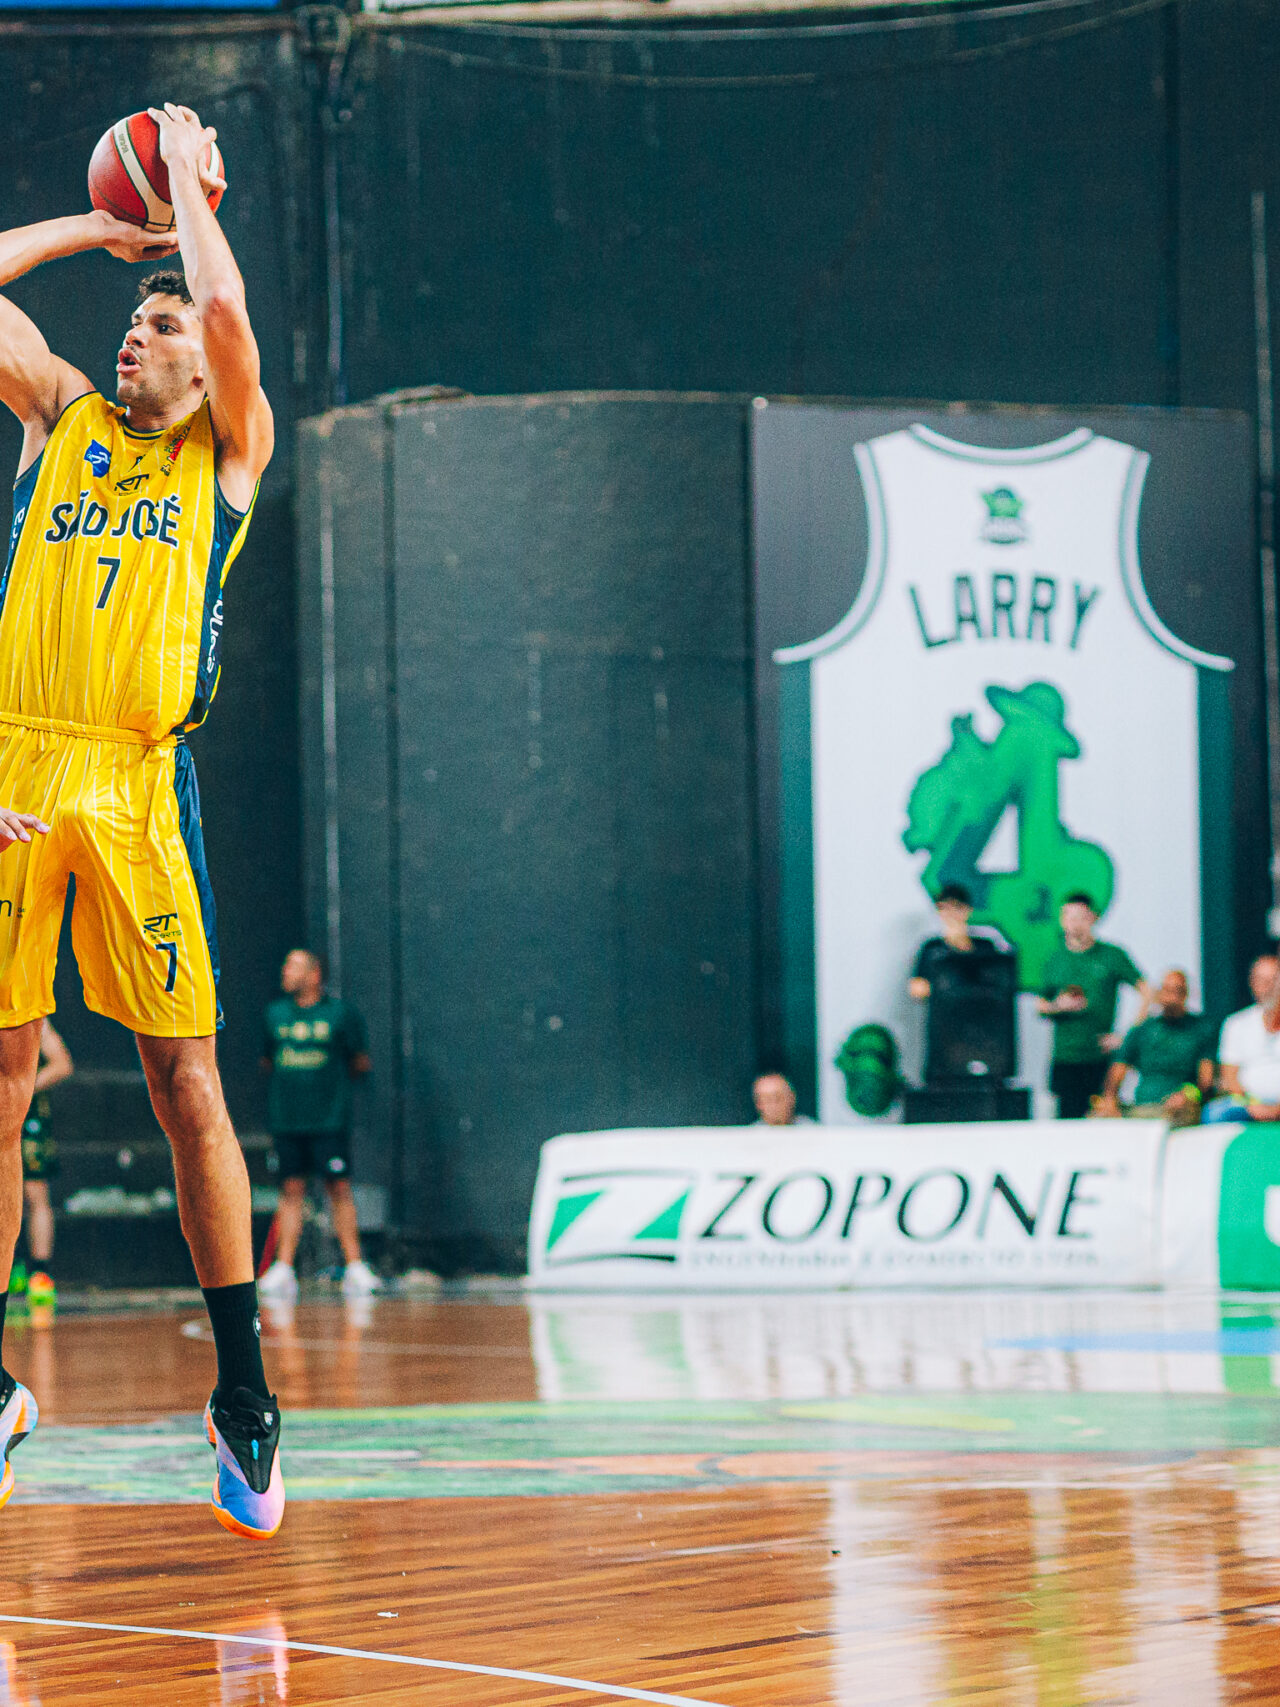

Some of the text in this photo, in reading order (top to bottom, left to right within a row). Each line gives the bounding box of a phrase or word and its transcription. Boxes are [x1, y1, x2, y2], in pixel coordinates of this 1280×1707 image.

[45, 491, 109, 543] SÃO
[96, 556, 121, 610] 7
[907, 571, 1103, 650] LARRY
[155, 941, 177, 992] 7
[697, 1167, 1108, 1244] ZOPONE
